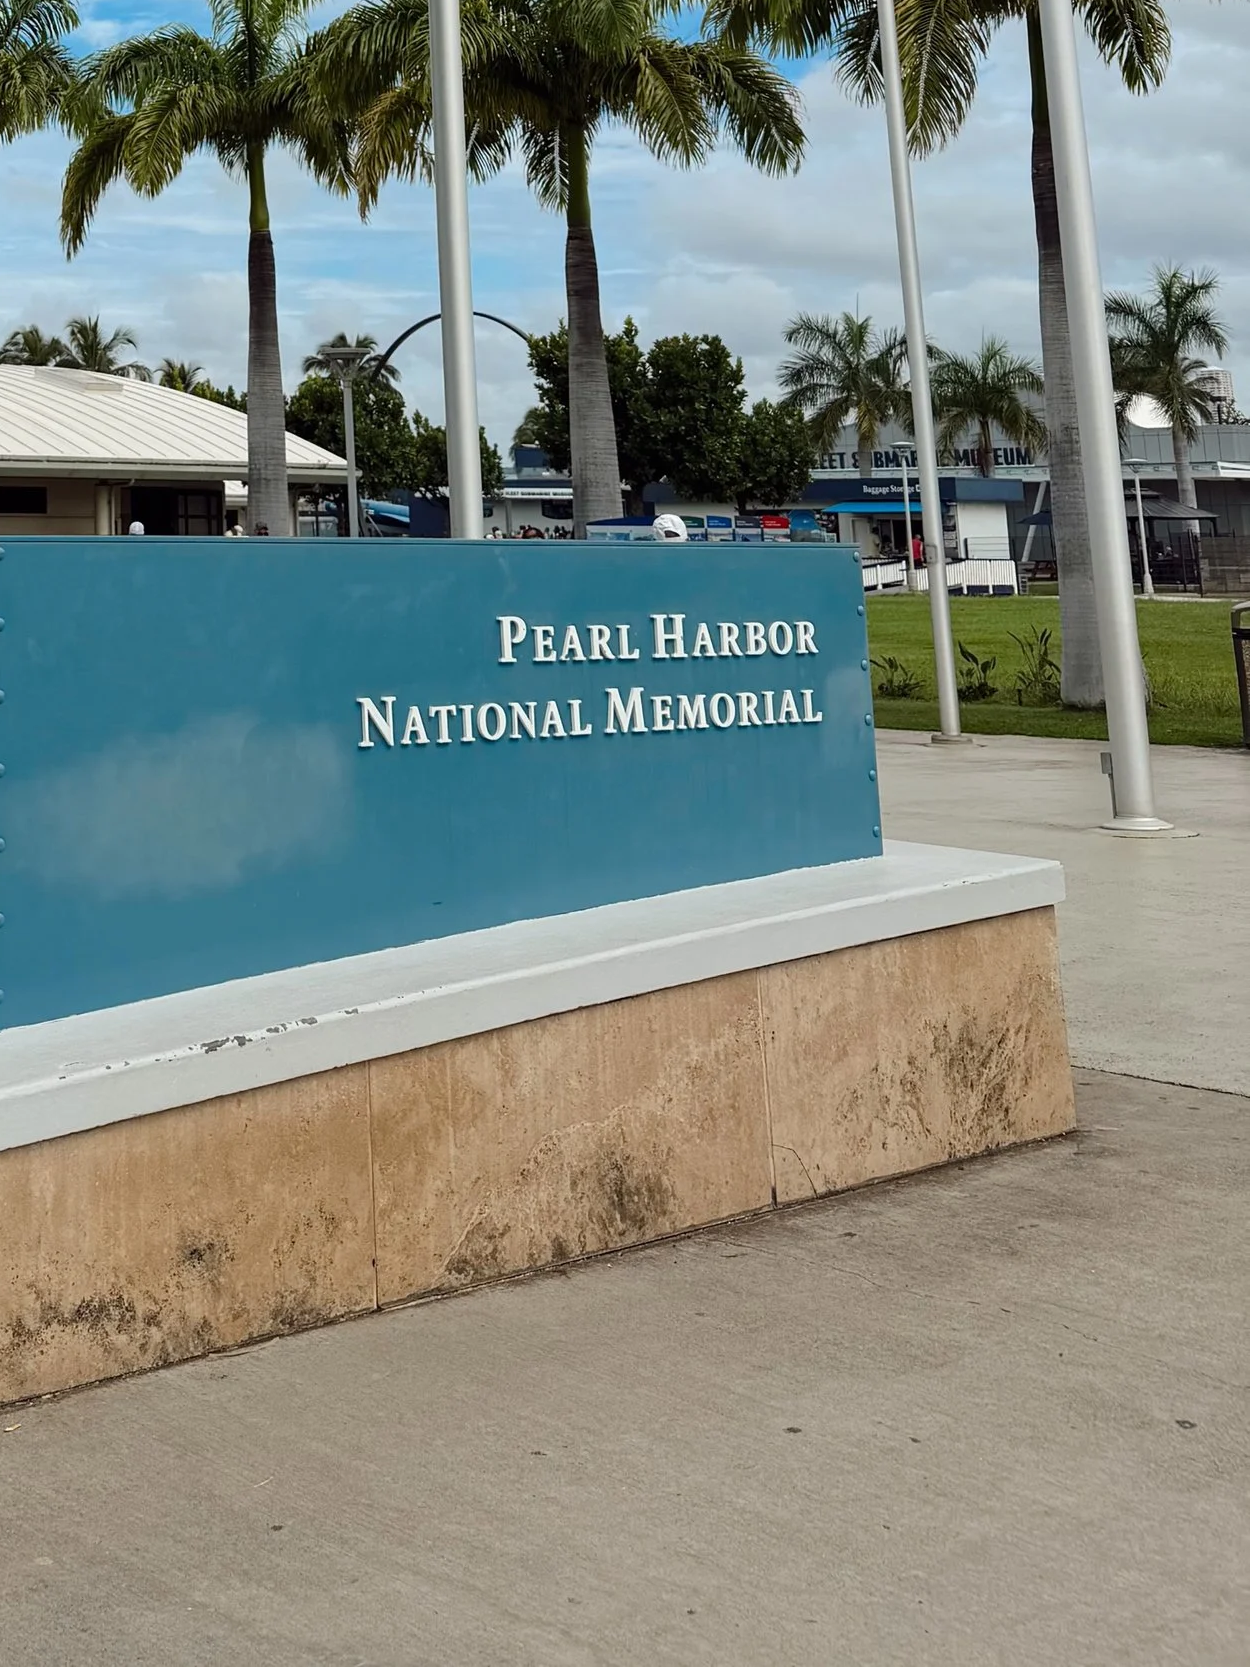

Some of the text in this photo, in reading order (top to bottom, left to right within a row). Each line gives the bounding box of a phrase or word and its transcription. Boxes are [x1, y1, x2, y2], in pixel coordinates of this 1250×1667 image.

[811, 452, 846, 470] EET
[954, 446, 1033, 467] MUEUM
[862, 484, 915, 495] Baggage Storge
[496, 613, 820, 664] PEARL HARBOR
[356, 686, 824, 748] NATIONAL MEMORIAL
